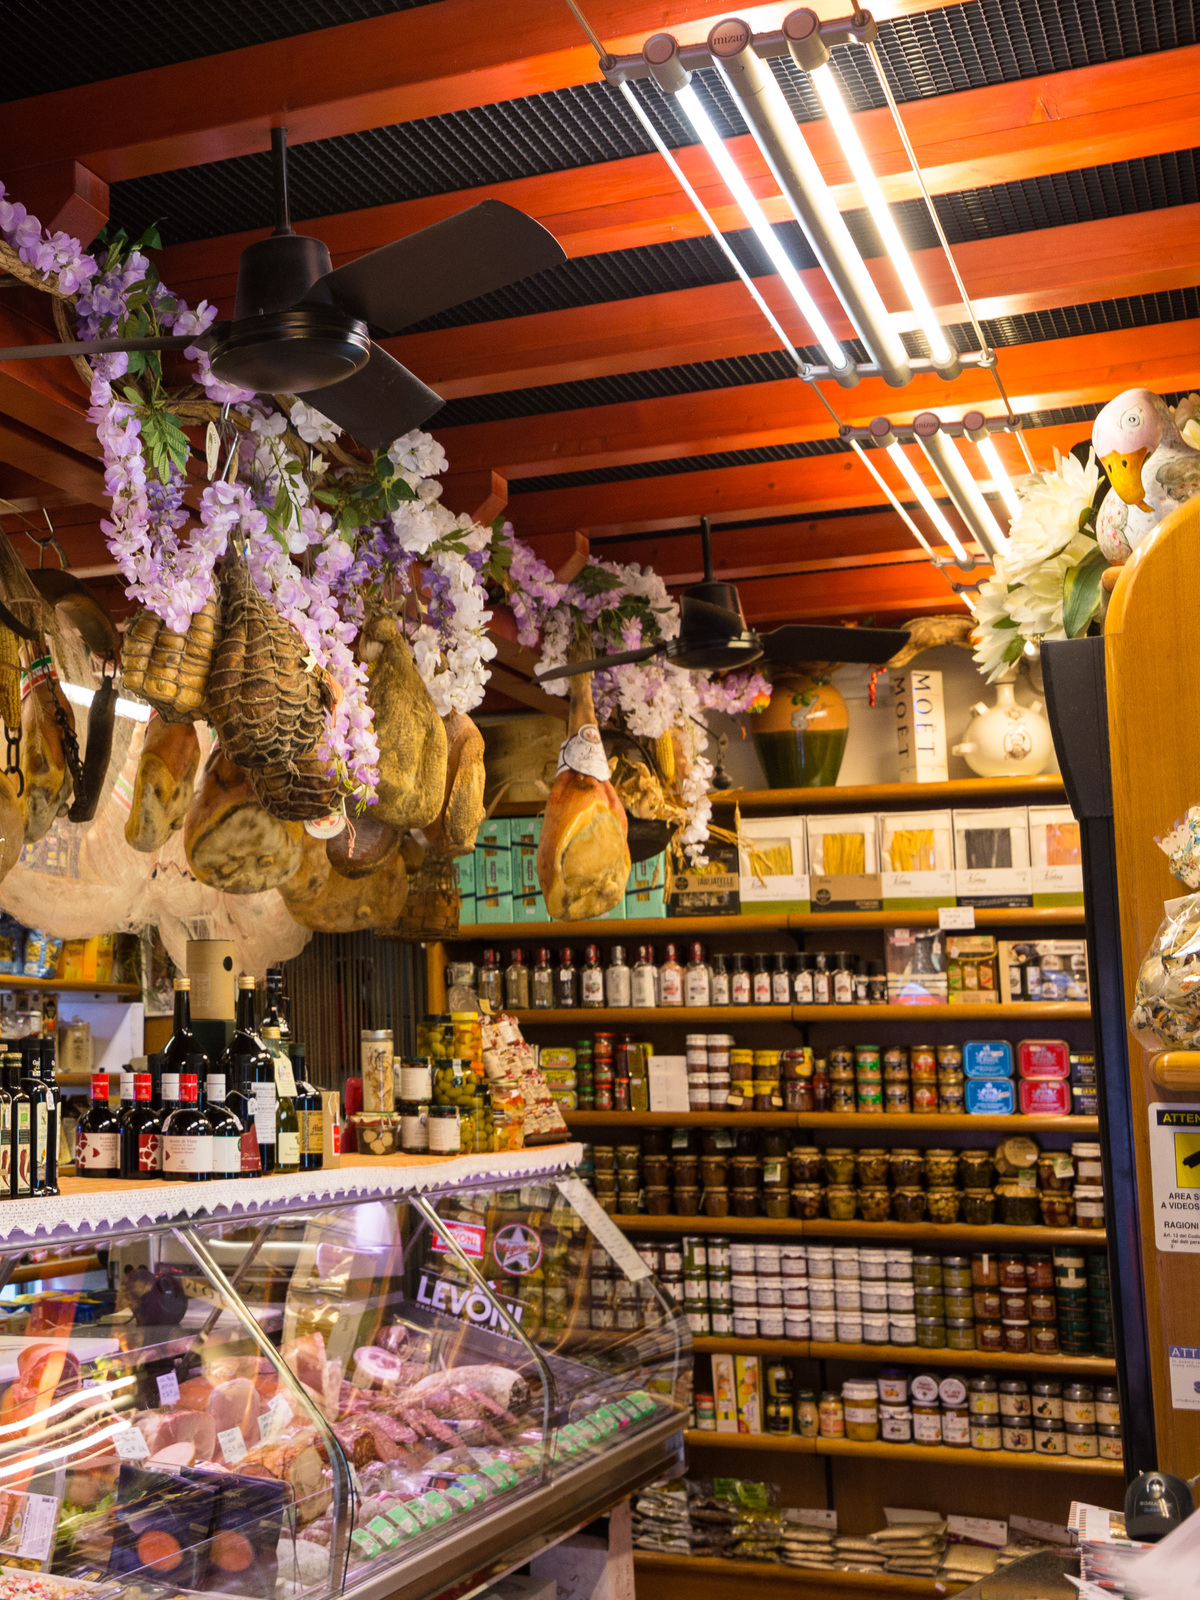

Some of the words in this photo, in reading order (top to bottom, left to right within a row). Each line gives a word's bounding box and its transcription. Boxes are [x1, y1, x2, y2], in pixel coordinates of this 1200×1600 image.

[713, 31, 745, 46] mizar
[1169, 1192, 1191, 1200] AREA
[1169, 1202, 1200, 1210] VIDEOS
[1164, 1221, 1199, 1230] RAGIONI
[417, 1275, 523, 1331] LEVONI
[1171, 1347, 1200, 1358] ATT
